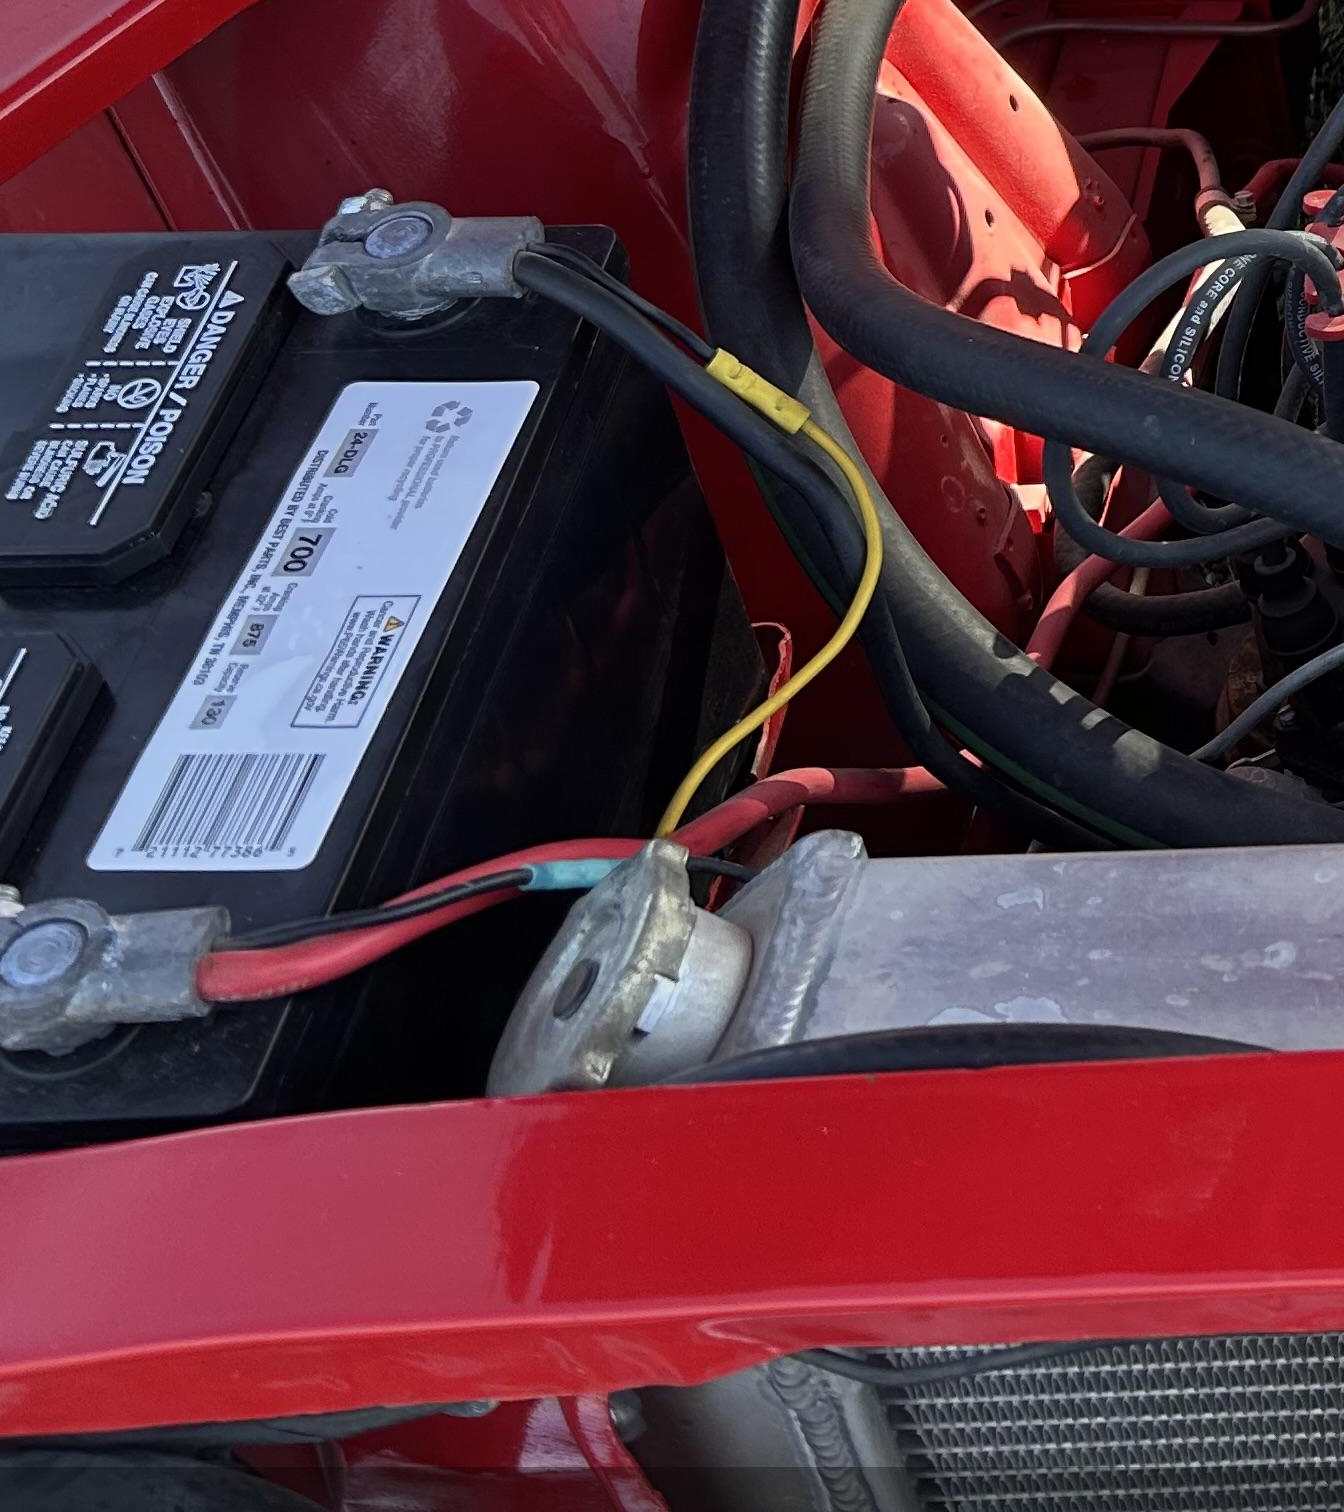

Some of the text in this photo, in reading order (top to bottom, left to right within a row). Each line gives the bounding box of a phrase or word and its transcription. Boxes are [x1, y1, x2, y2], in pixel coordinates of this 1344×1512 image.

[1206, 268, 1236, 300] CORE
[132, 296, 160, 329] GASES
[135, 296, 175, 349] EXPLOSIVE
[1190, 300, 1209, 325] and
[153, 318, 178, 344] EYES
[163, 318, 192, 353] SHIELD
[174, 311, 236, 389] DANGER
[121, 409, 182, 484] POISON
[332, 432, 369, 473] 24-DLG
[50, 440, 88, 493] SULFURIC
[289, 449, 330, 501] DISTRIBUTED
[282, 504, 300, 516] BY
[269, 518, 293, 539] BEST
[280, 534, 323, 572] 700
[239, 623, 266, 647] 875
[198, 699, 227, 725] 130
